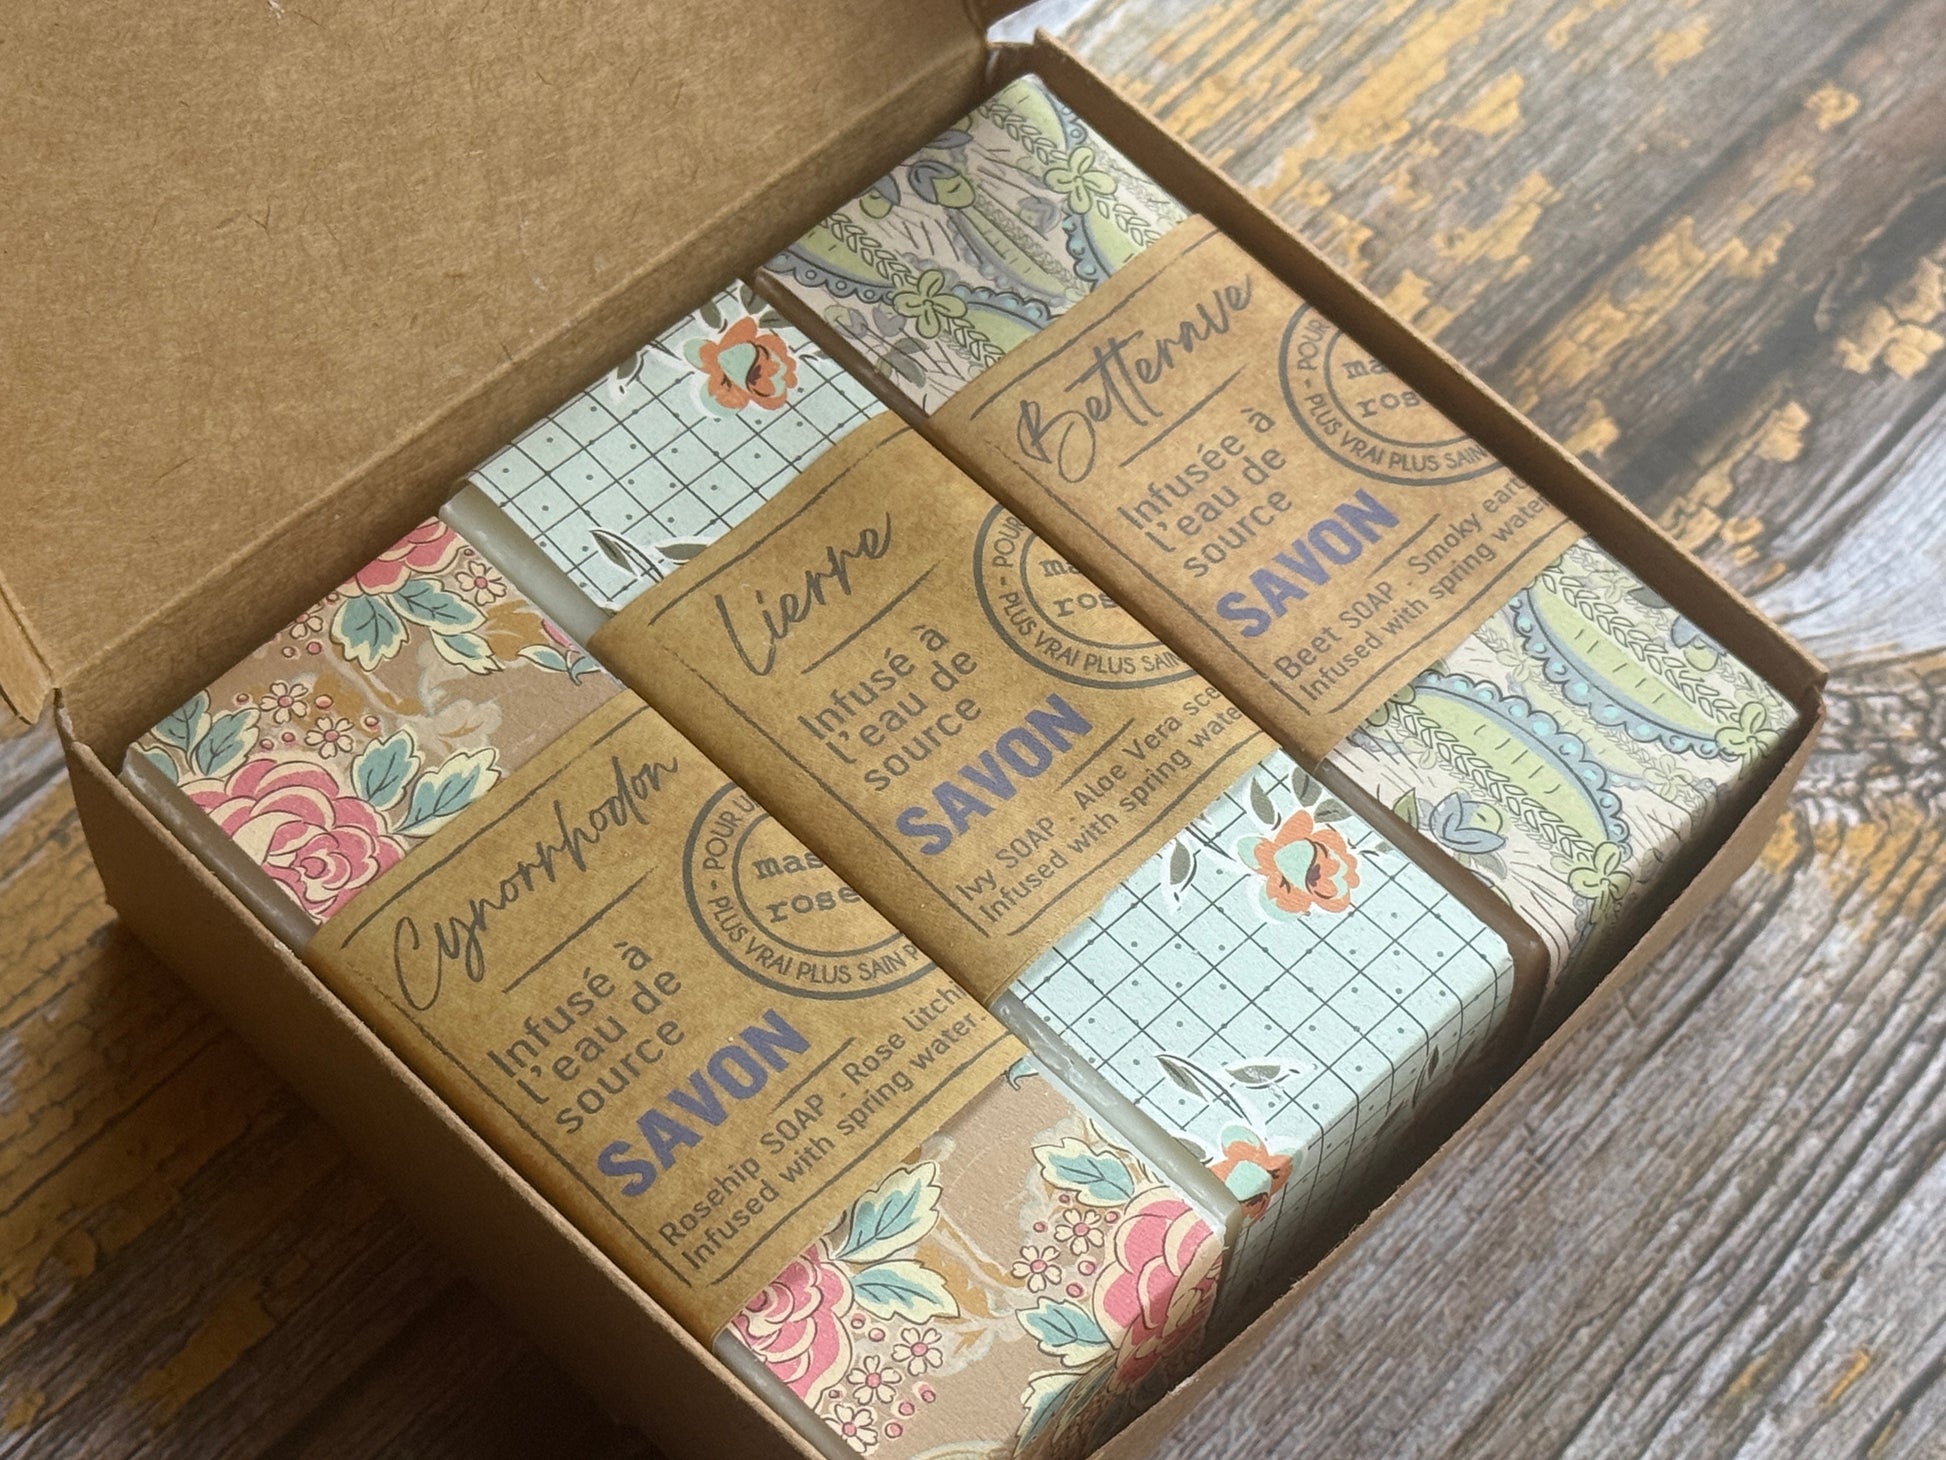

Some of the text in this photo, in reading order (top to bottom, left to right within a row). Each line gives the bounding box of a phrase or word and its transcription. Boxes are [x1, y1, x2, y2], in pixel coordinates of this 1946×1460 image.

[1016, 273, 1252, 484] Betterave
[1297, 318, 1332, 371] POUR
[1117, 407, 1275, 529] Infusée à
[1304, 392, 1342, 436] PLUS
[1340, 430, 1383, 464] VRAI
[1388, 452, 1440, 473] PLUS
[1443, 444, 1488, 469] SAIN
[1145, 448, 1287, 552] l'eau de
[1183, 490, 1292, 578] source
[1216, 488, 1400, 637] SAVON
[714, 512, 892, 676] Lierre
[998, 591, 1037, 636] PLUS
[1034, 630, 1079, 667] VRAI
[1083, 653, 1136, 675] PLUS
[1273, 626, 1342, 681] Beet
[1338, 581, 1393, 629] SOAP
[1408, 512, 1483, 575] Smoky
[1299, 631, 1384, 701] Infused
[1380, 598, 1429, 636] with
[1428, 542, 1498, 600] spring
[797, 624, 949, 740] Infusé à
[825, 651, 978, 764] l'eau de
[864, 697, 982, 792] source
[895, 692, 1094, 856] SAVON
[955, 868, 998, 901] Ivy
[995, 816, 1055, 870] SOAP
[1071, 763, 1128, 811] Aloe
[1121, 716, 1183, 761] Vera
[978, 848, 1069, 923] Infused
[1067, 811, 1120, 855] with
[1119, 749, 1192, 812] spring
[394, 756, 679, 1011] Cynorrhodon
[702, 810, 743, 870] POUR
[752, 851, 824, 880] mas
[708, 895, 749, 943] PLUS
[746, 935, 794, 976] VRAI
[796, 961, 852, 984] PLUS
[857, 950, 908, 981] SAIN
[766, 887, 861, 923] rose
[487, 941, 653, 1078] Infusé à
[516, 971, 682, 1105] l'eau de
[555, 1020, 685, 1134] source
[597, 1008, 812, 1198] SAVON
[658, 1156, 761, 1247] Rosehip
[761, 1093, 825, 1155] SOAP
[841, 1033, 906, 1086] Rose
[681, 1179, 780, 1271] Infused
[779, 1134, 836, 1184] with
[836, 1070, 915, 1136] spring
